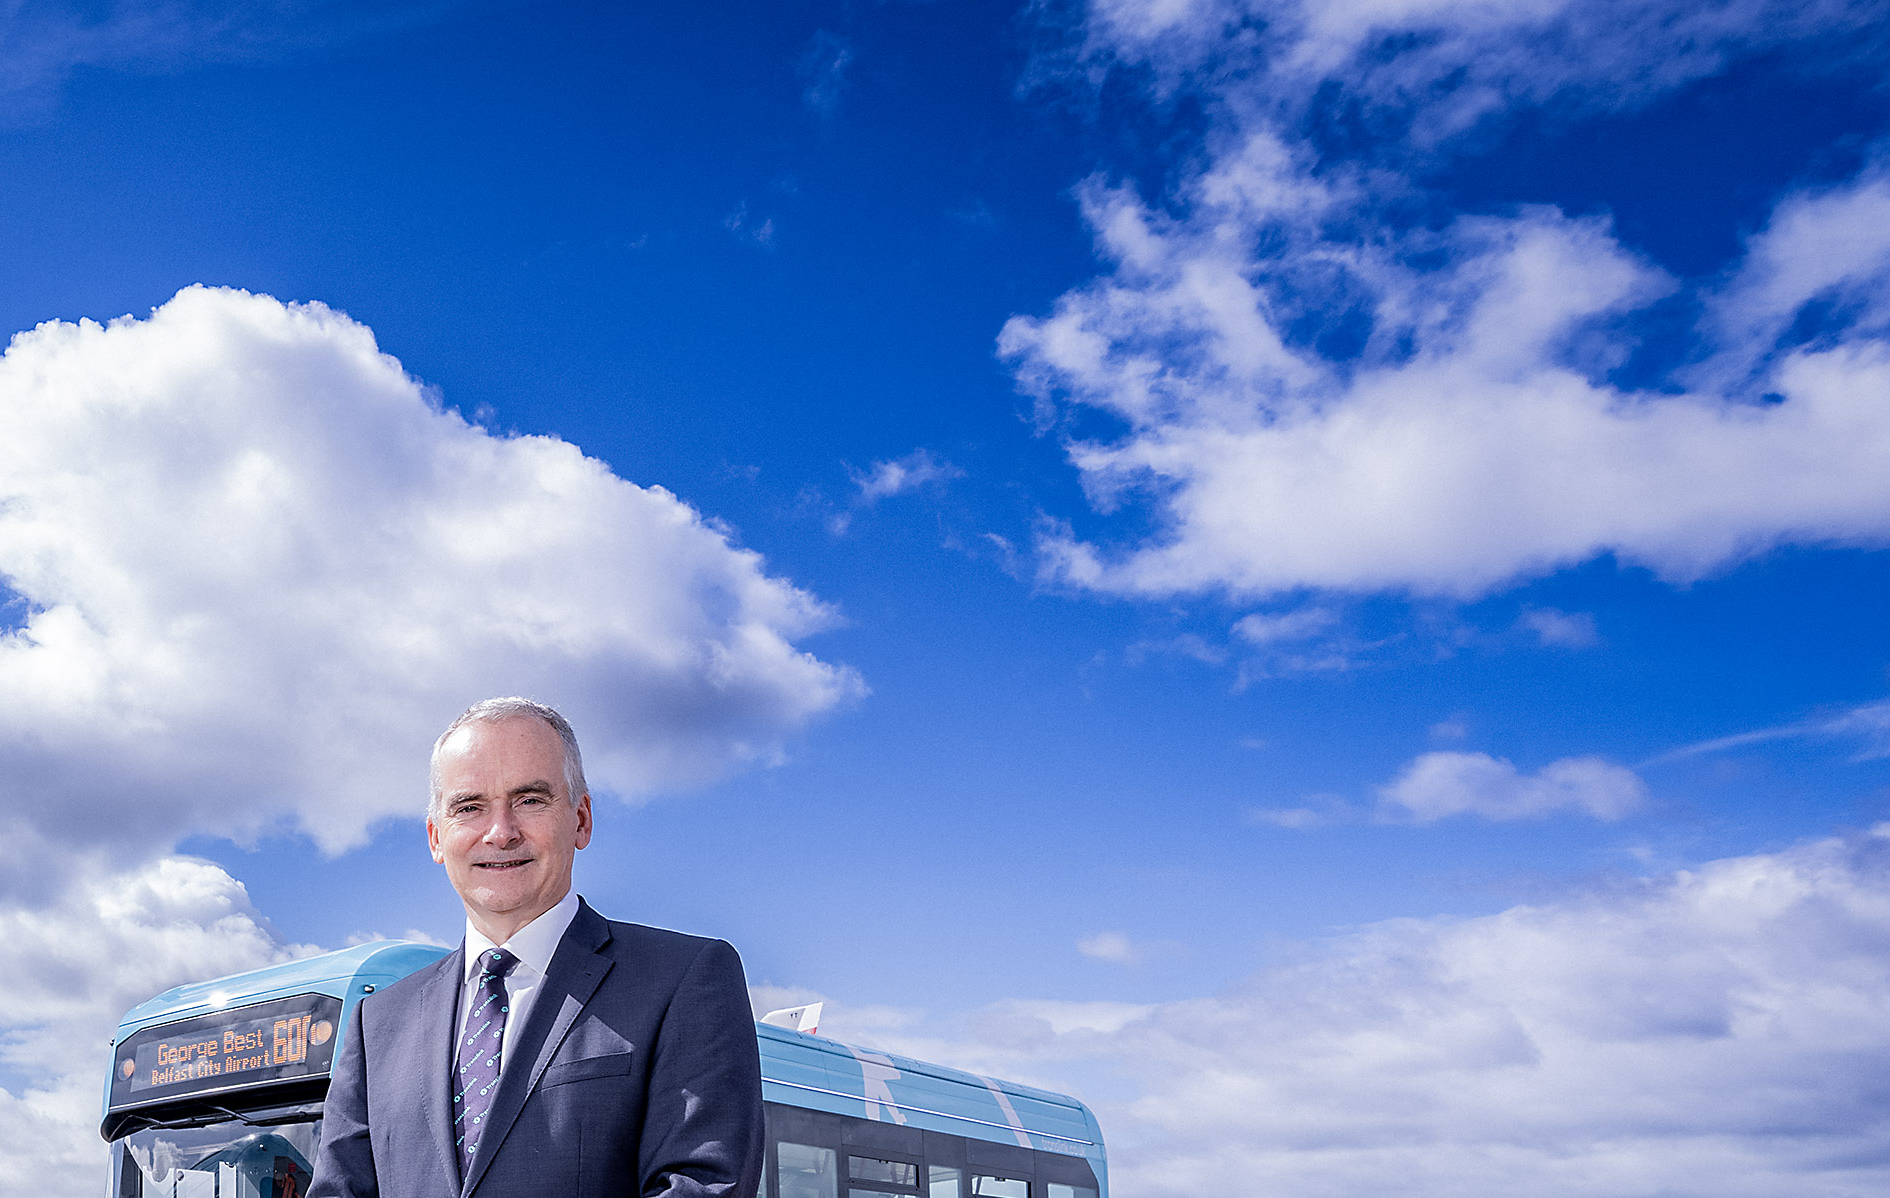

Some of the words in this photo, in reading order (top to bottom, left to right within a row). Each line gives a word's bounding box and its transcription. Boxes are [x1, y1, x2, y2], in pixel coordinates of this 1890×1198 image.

[158, 1039, 218, 1066] George
[223, 1029, 264, 1054] Best
[151, 1061, 193, 1086] Belfast
[197, 1058, 221, 1078] City
[225, 1049, 270, 1073] Airport
